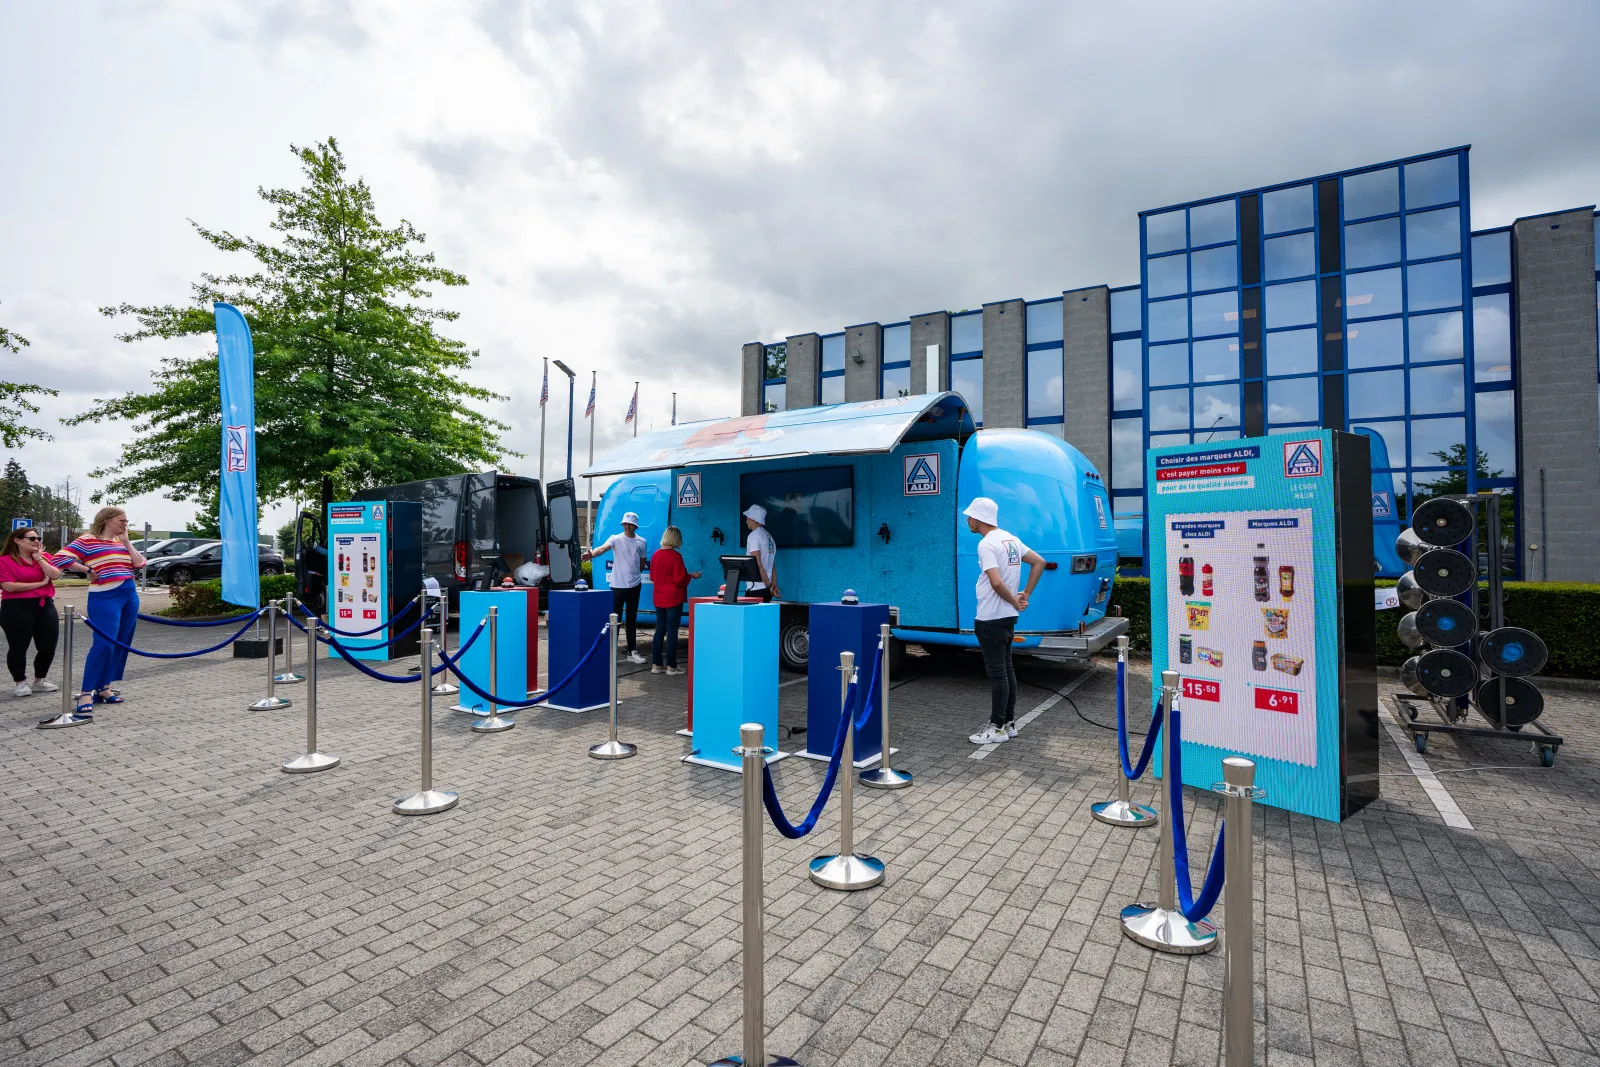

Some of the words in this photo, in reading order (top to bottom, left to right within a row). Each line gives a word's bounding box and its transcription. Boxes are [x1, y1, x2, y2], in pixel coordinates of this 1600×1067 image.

[1160, 456, 1184, 465] Choisir
[1185, 455, 1199, 463] des
[1200, 453, 1232, 462] marques
[1233, 449, 1255, 458] ALDI,
[1161, 469, 1177, 478] c'est
[1178, 469, 1199, 479] payer
[1200, 467, 1222, 475] moins
[1223, 465, 1240, 473] cher
[1291, 466, 1317, 474] ALDI
[1161, 485, 1177, 493] pour
[1175, 522, 1197, 530] Grandes
[1197, 522, 1221, 530] marques
[1252, 520, 1279, 528] Marques
